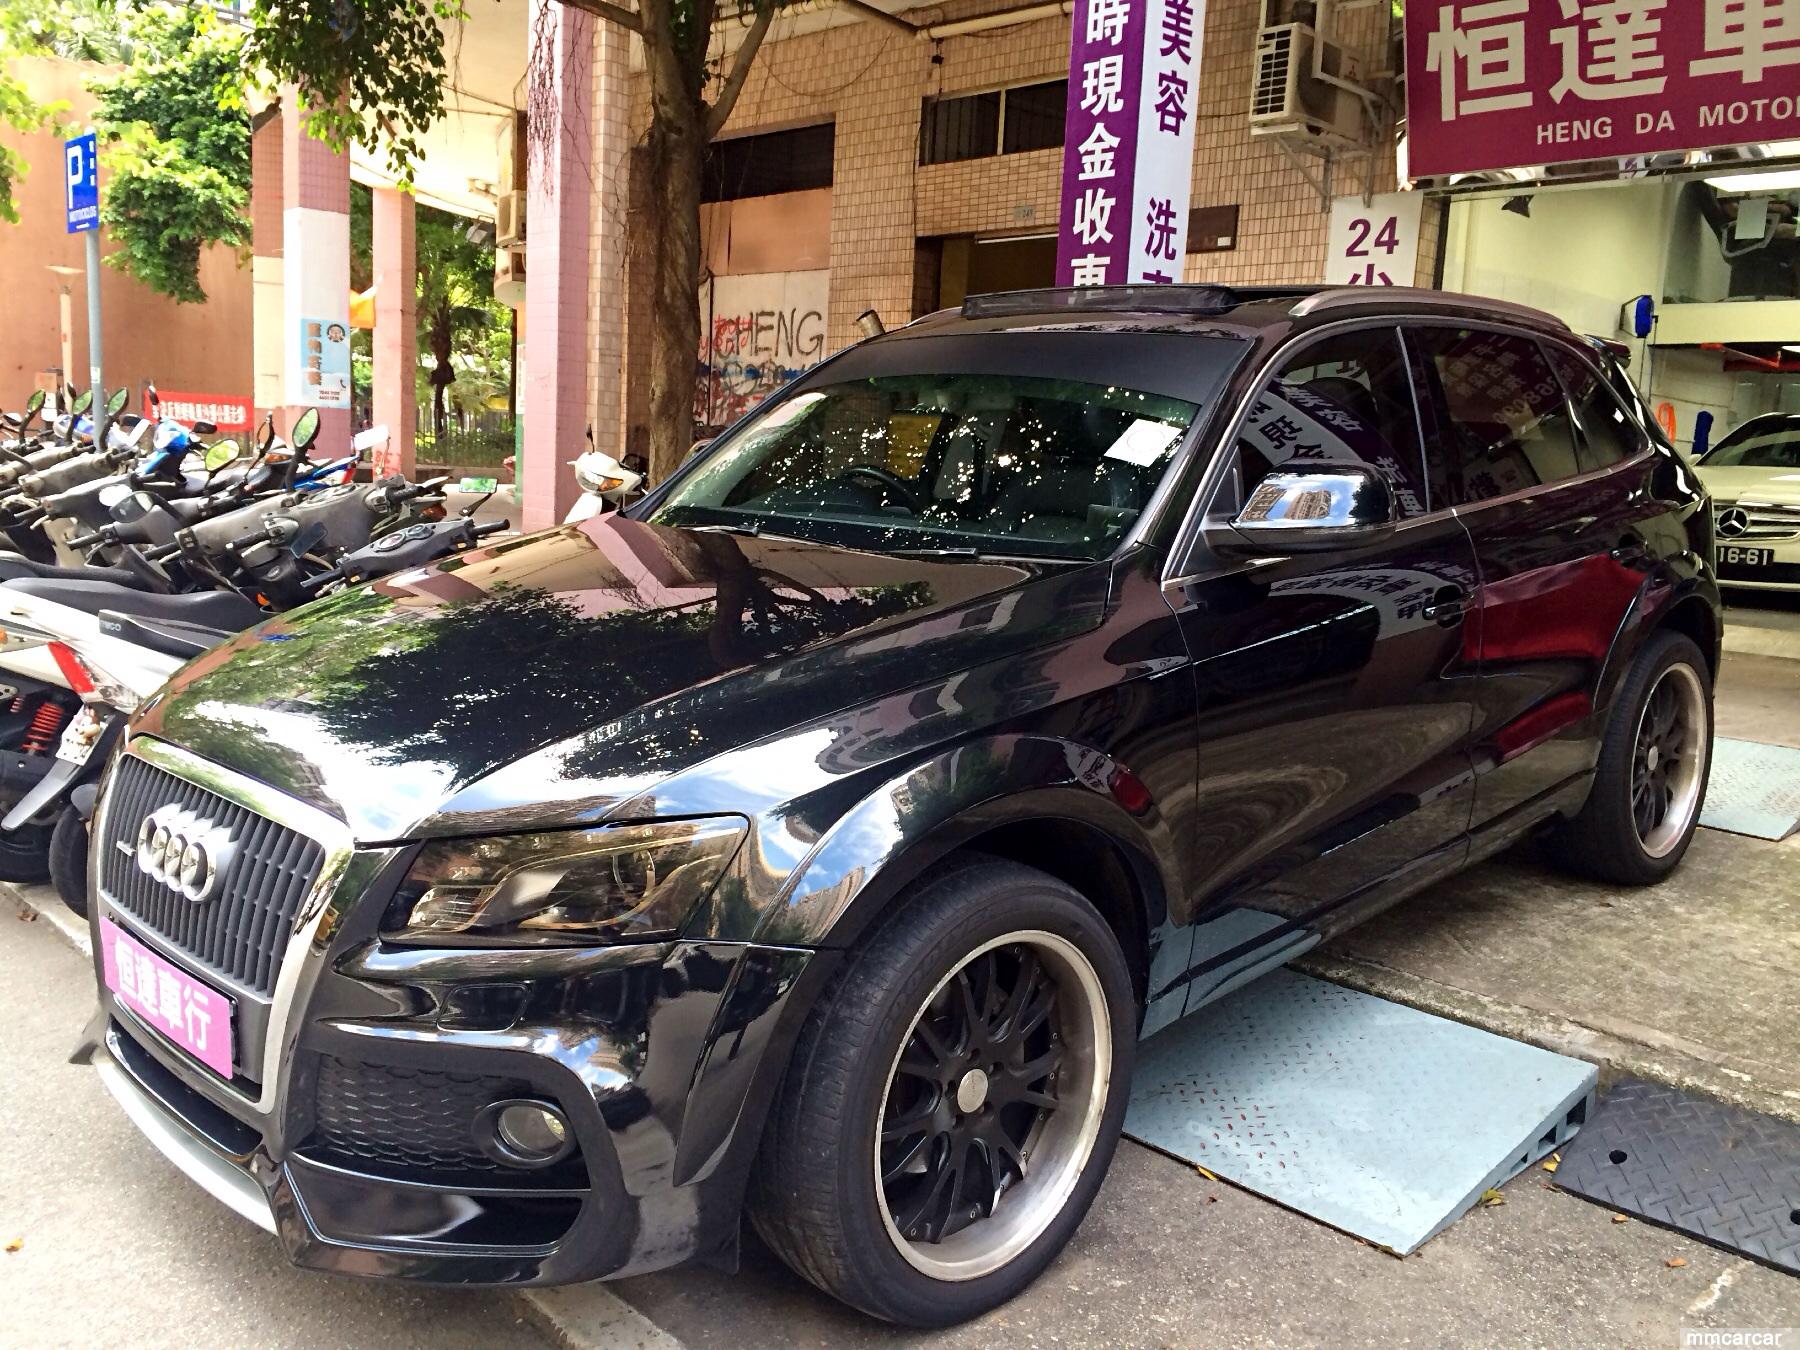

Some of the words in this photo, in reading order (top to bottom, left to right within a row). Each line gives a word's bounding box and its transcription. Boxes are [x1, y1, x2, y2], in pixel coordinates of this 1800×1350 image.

[1155, 0, 1194, 136] 美容
[1425, 0, 1800, 122] 恒達車
[1536, 116, 1613, 145] HENG
[1635, 110, 1676, 135] DA
[1699, 96, 1800, 128] MOTO
[1143, 197, 1177, 284] 洗
[1345, 216, 1400, 258] 24
[115, 935, 212, 1050] 恒達車行
